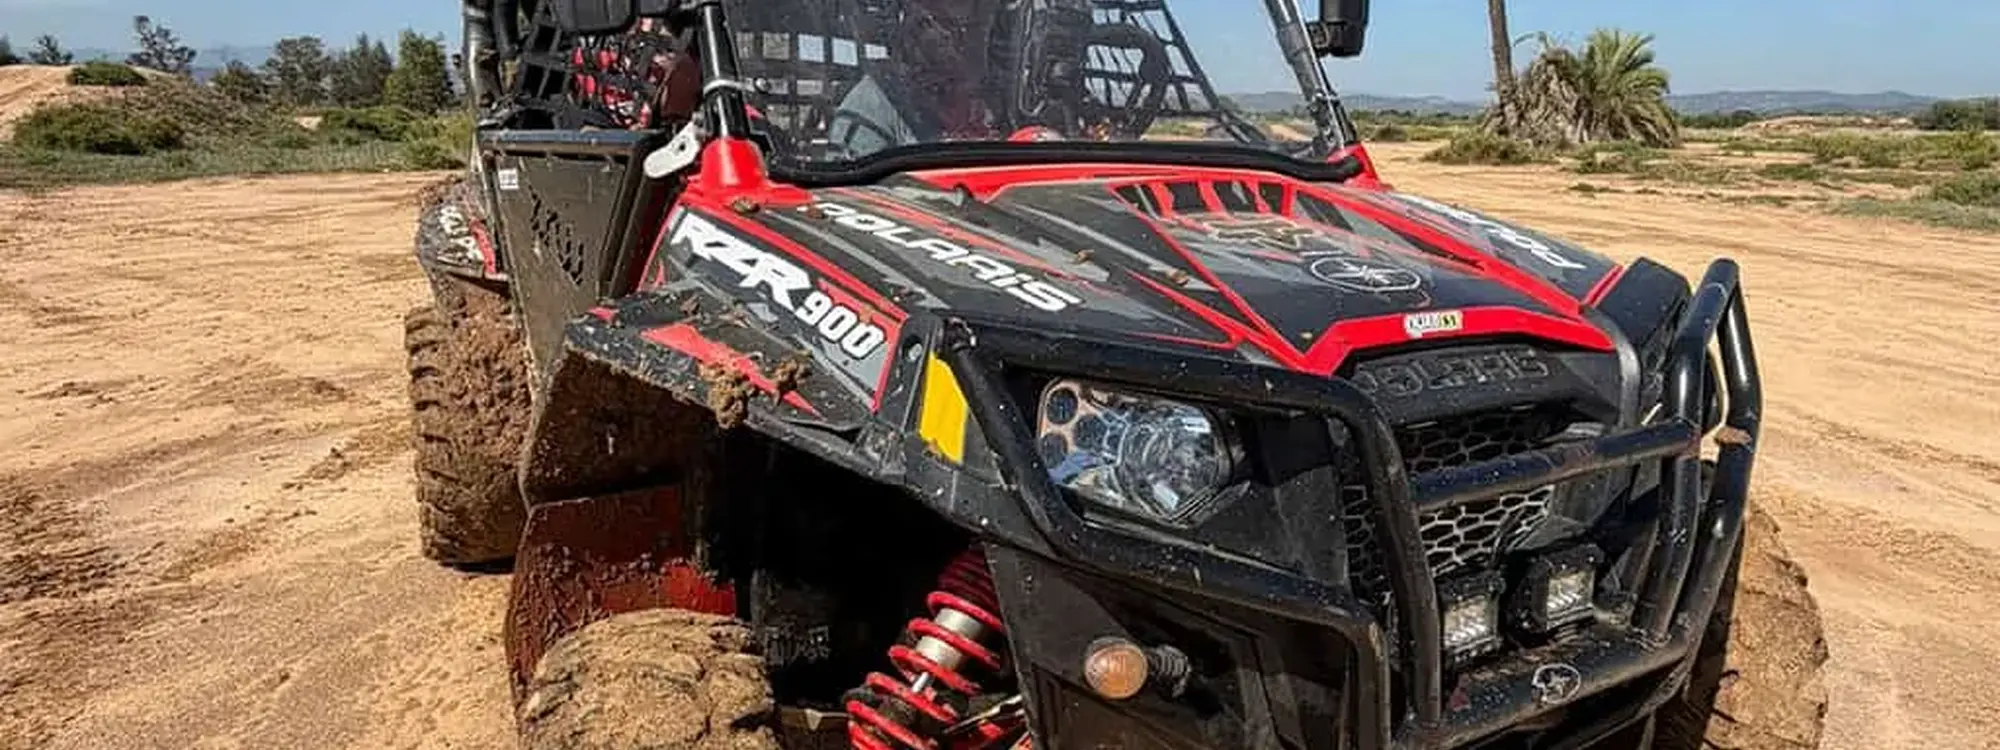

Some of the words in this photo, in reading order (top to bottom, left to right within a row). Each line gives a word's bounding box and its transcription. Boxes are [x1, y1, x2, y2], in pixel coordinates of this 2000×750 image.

[671, 212, 812, 312] RZR
[795, 291, 886, 358] 900
[797, 202, 1085, 312] POLARIS
